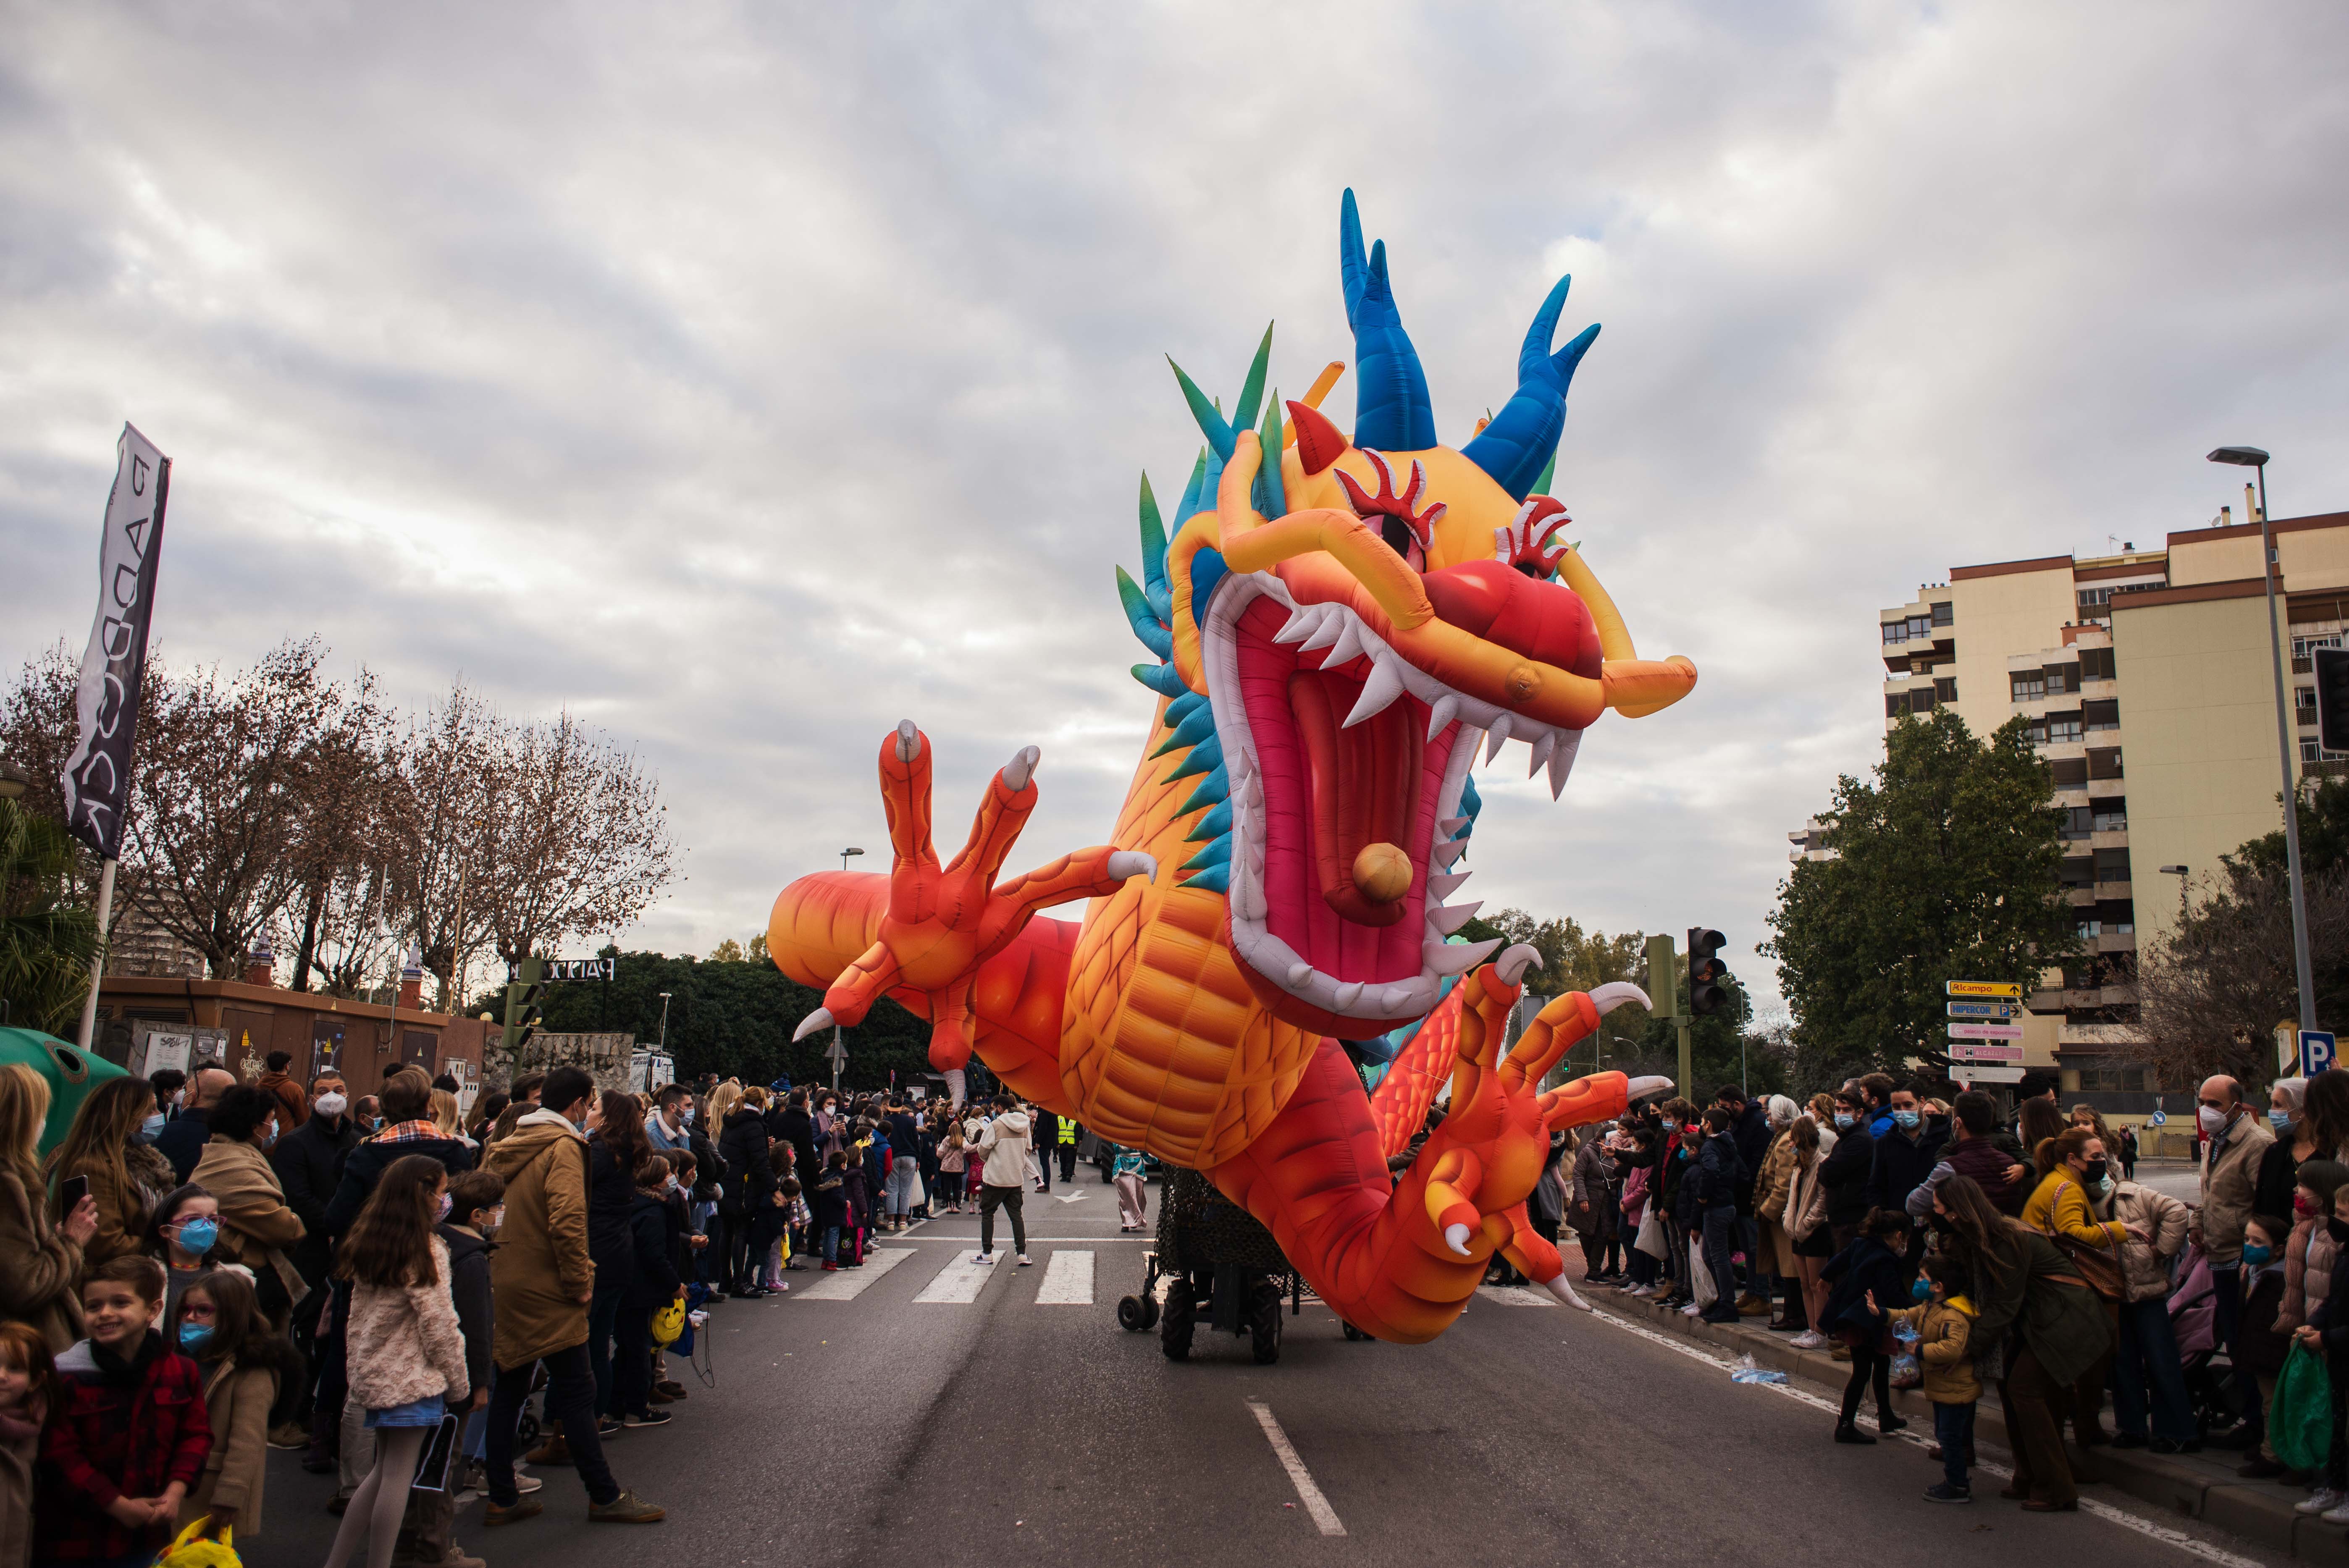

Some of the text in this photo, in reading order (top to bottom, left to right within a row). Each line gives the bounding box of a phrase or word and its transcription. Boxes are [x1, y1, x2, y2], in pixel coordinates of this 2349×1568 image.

[1953, 983, 1992, 993] Alcampo
[1953, 1005, 1990, 1014] HIPERCOR
[2307, 1040, 2328, 1072] P
